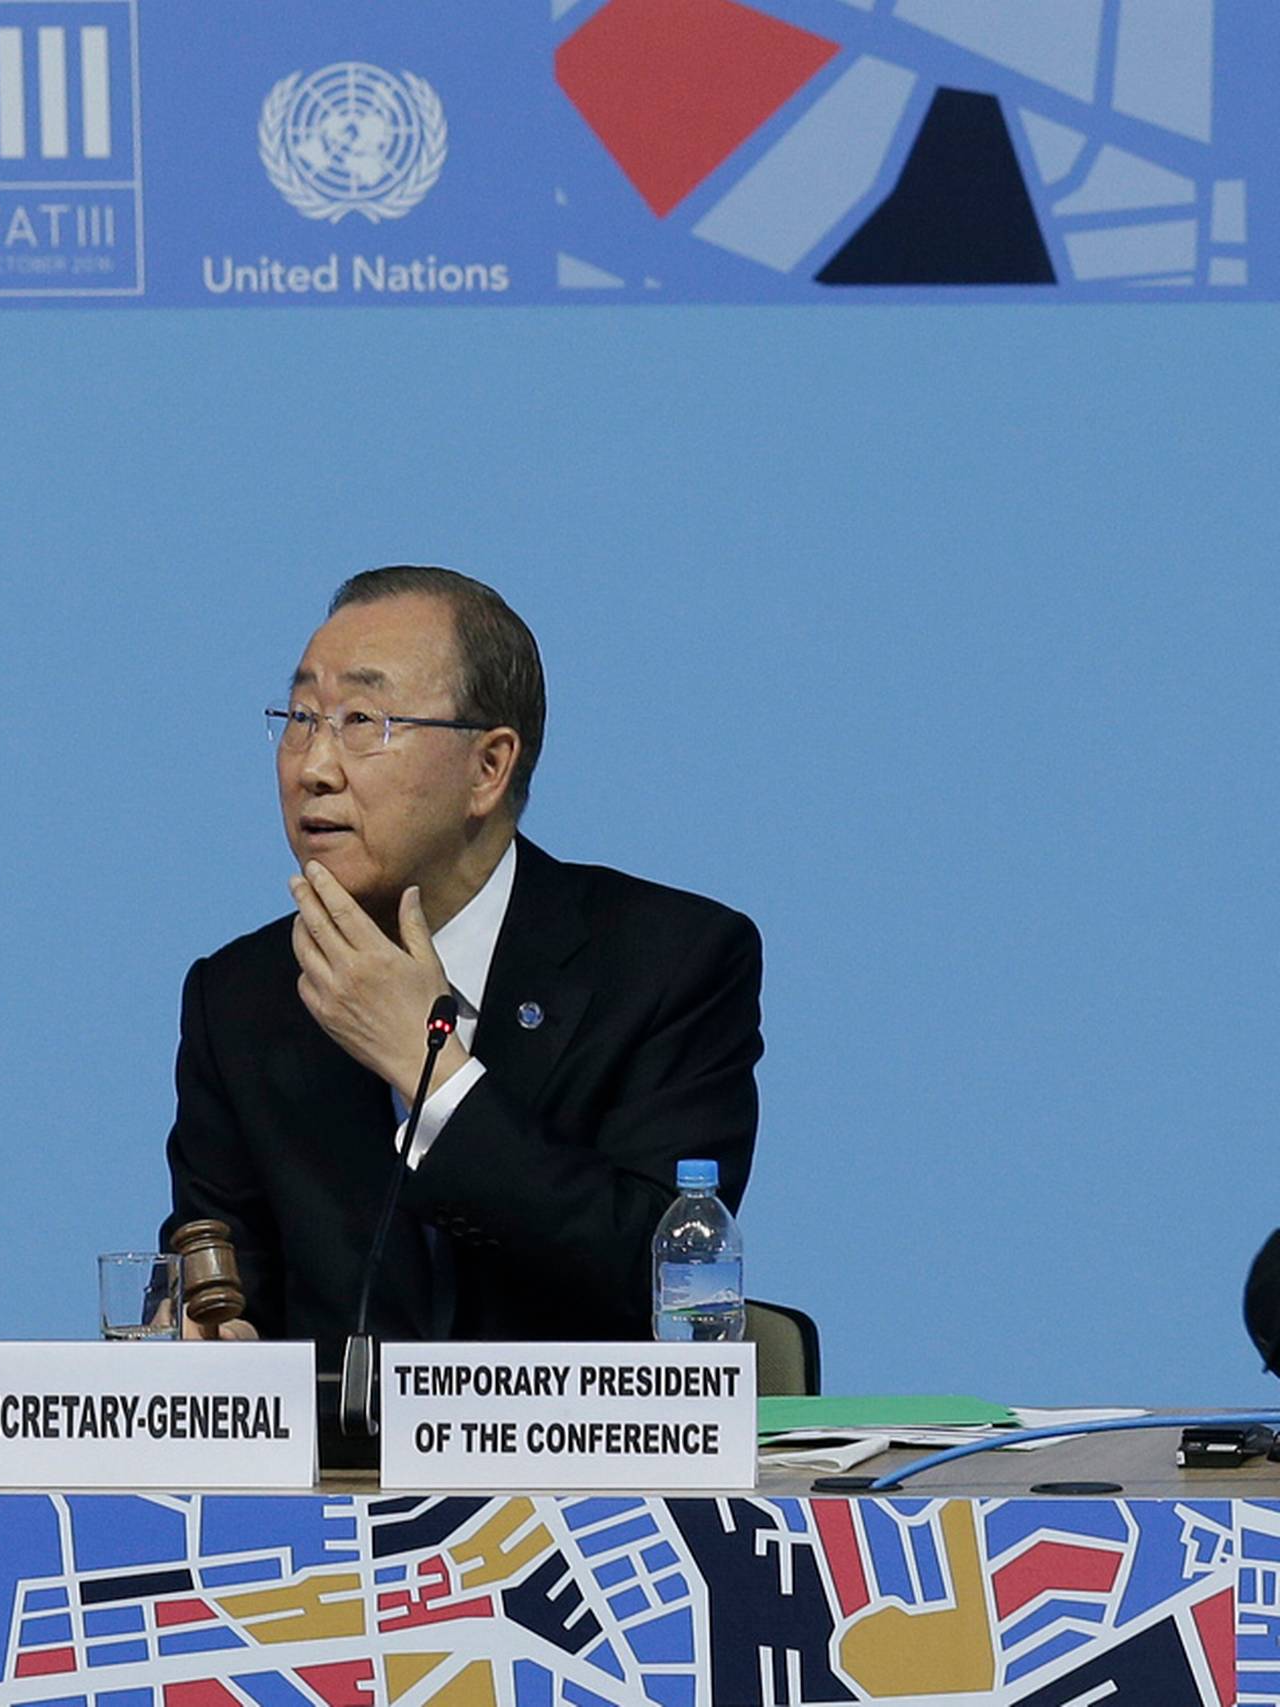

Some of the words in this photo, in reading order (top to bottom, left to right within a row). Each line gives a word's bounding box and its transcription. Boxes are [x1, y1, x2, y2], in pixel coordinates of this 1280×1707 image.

[202, 253, 339, 293] United
[352, 253, 509, 293] Nations
[394, 1365, 571, 1397] TEMPORARY
[579, 1365, 741, 1397] PRESIDENT
[414, 1422, 452, 1455] OF
[460, 1422, 517, 1455] THE
[526, 1422, 720, 1455] CONFERENCE
